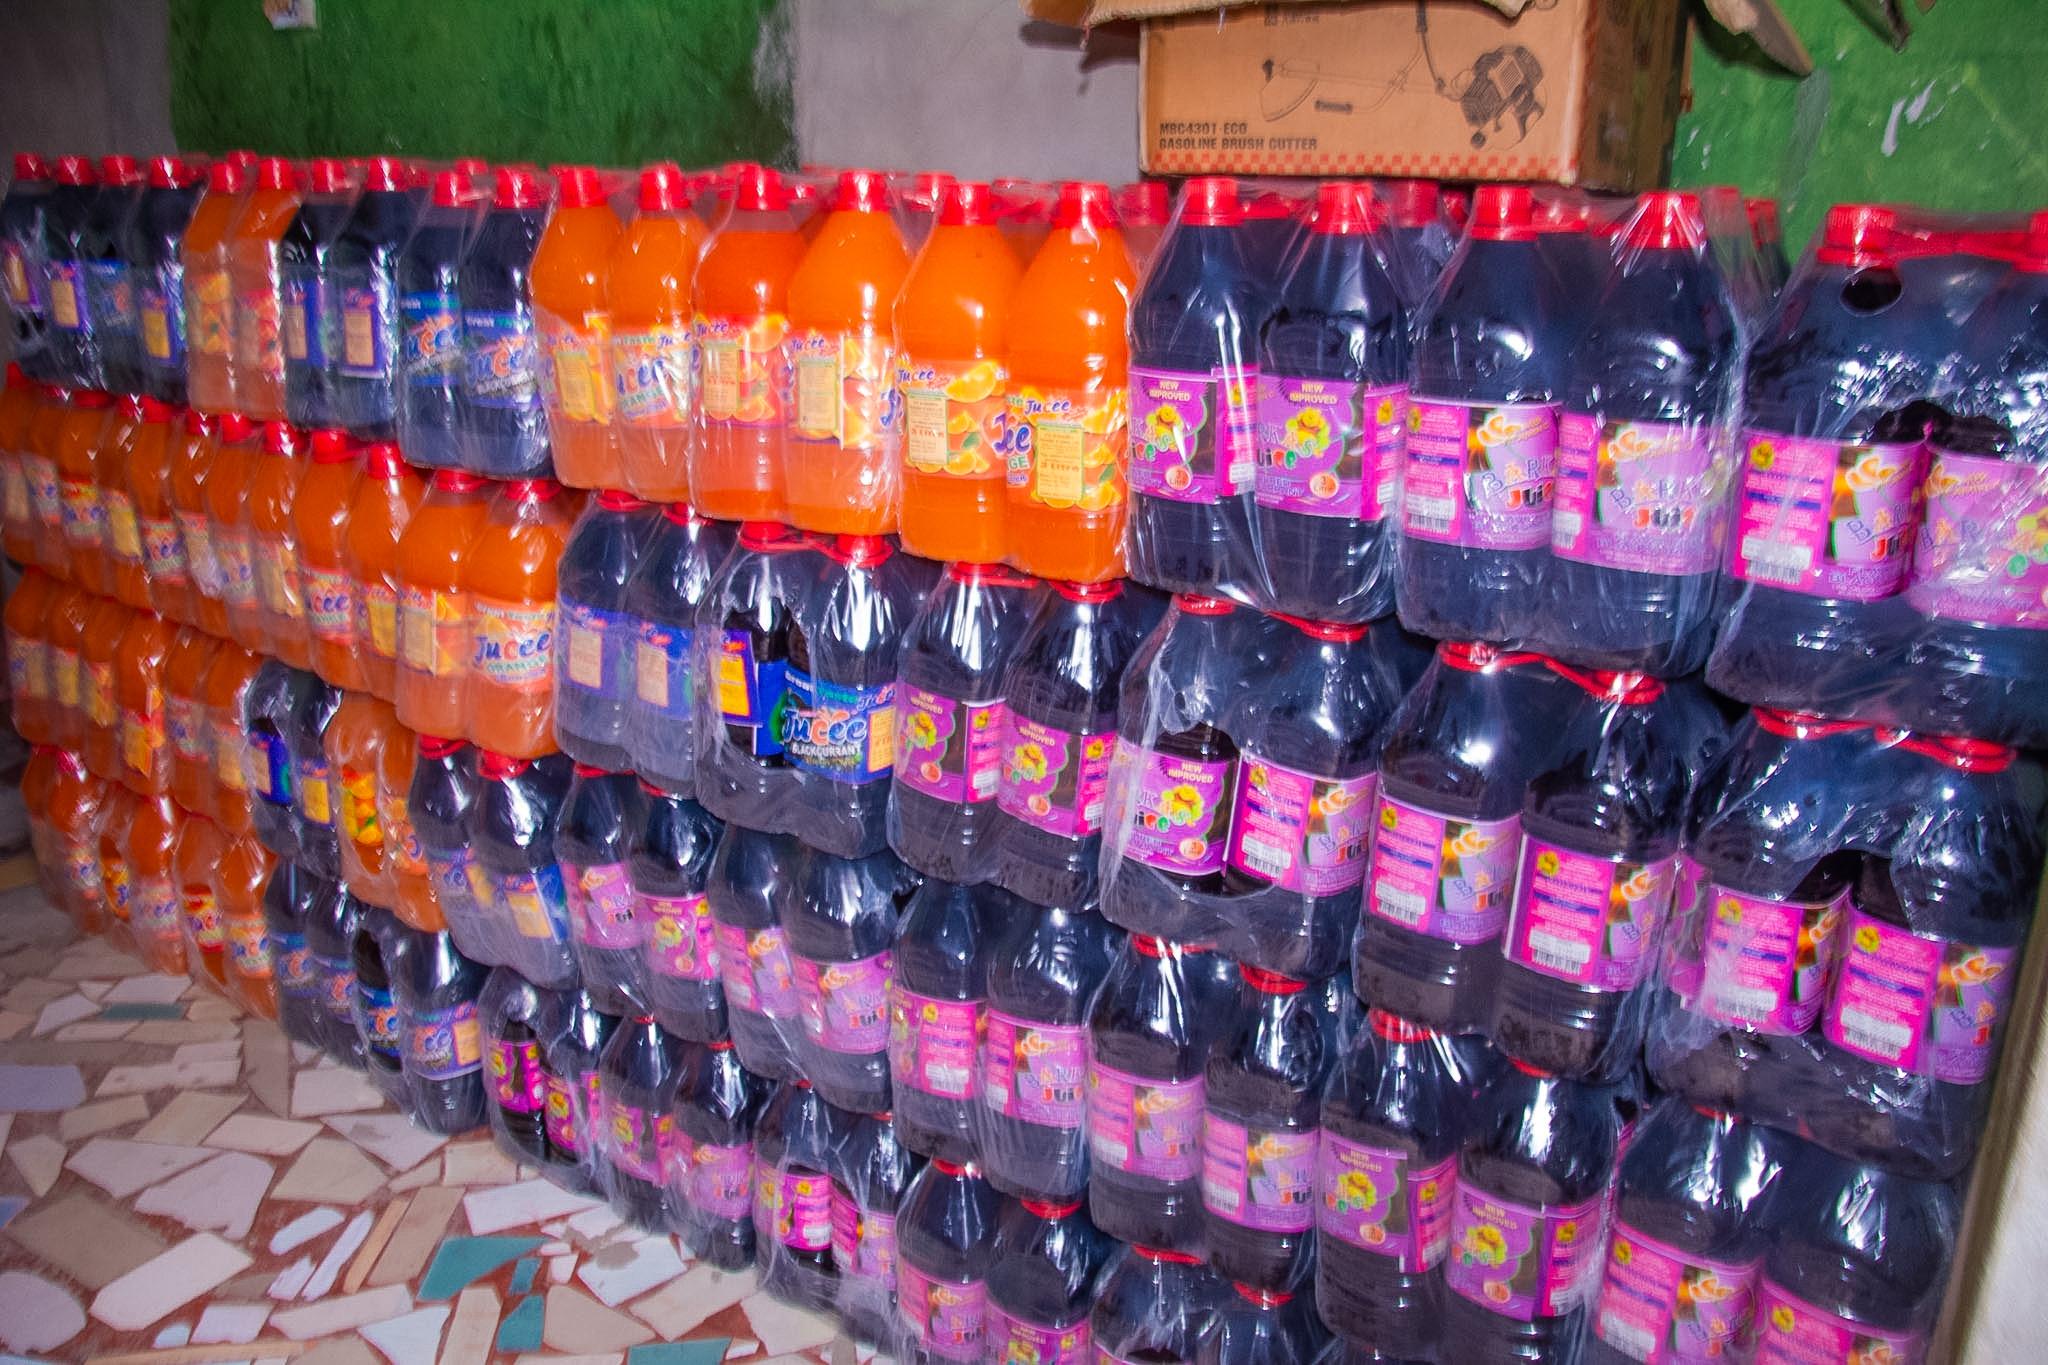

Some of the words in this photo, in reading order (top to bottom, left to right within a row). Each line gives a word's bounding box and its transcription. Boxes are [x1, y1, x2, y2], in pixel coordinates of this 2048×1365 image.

[1159, 138, 1217, 150] GASOLINE
[1221, 138, 1264, 150] BRUSH
[1268, 138, 1318, 150] CUTTER
[472, 632, 552, 669] Jucee
[781, 709, 868, 747] Jucee
[790, 742, 860, 759] BLACKCURRANT
